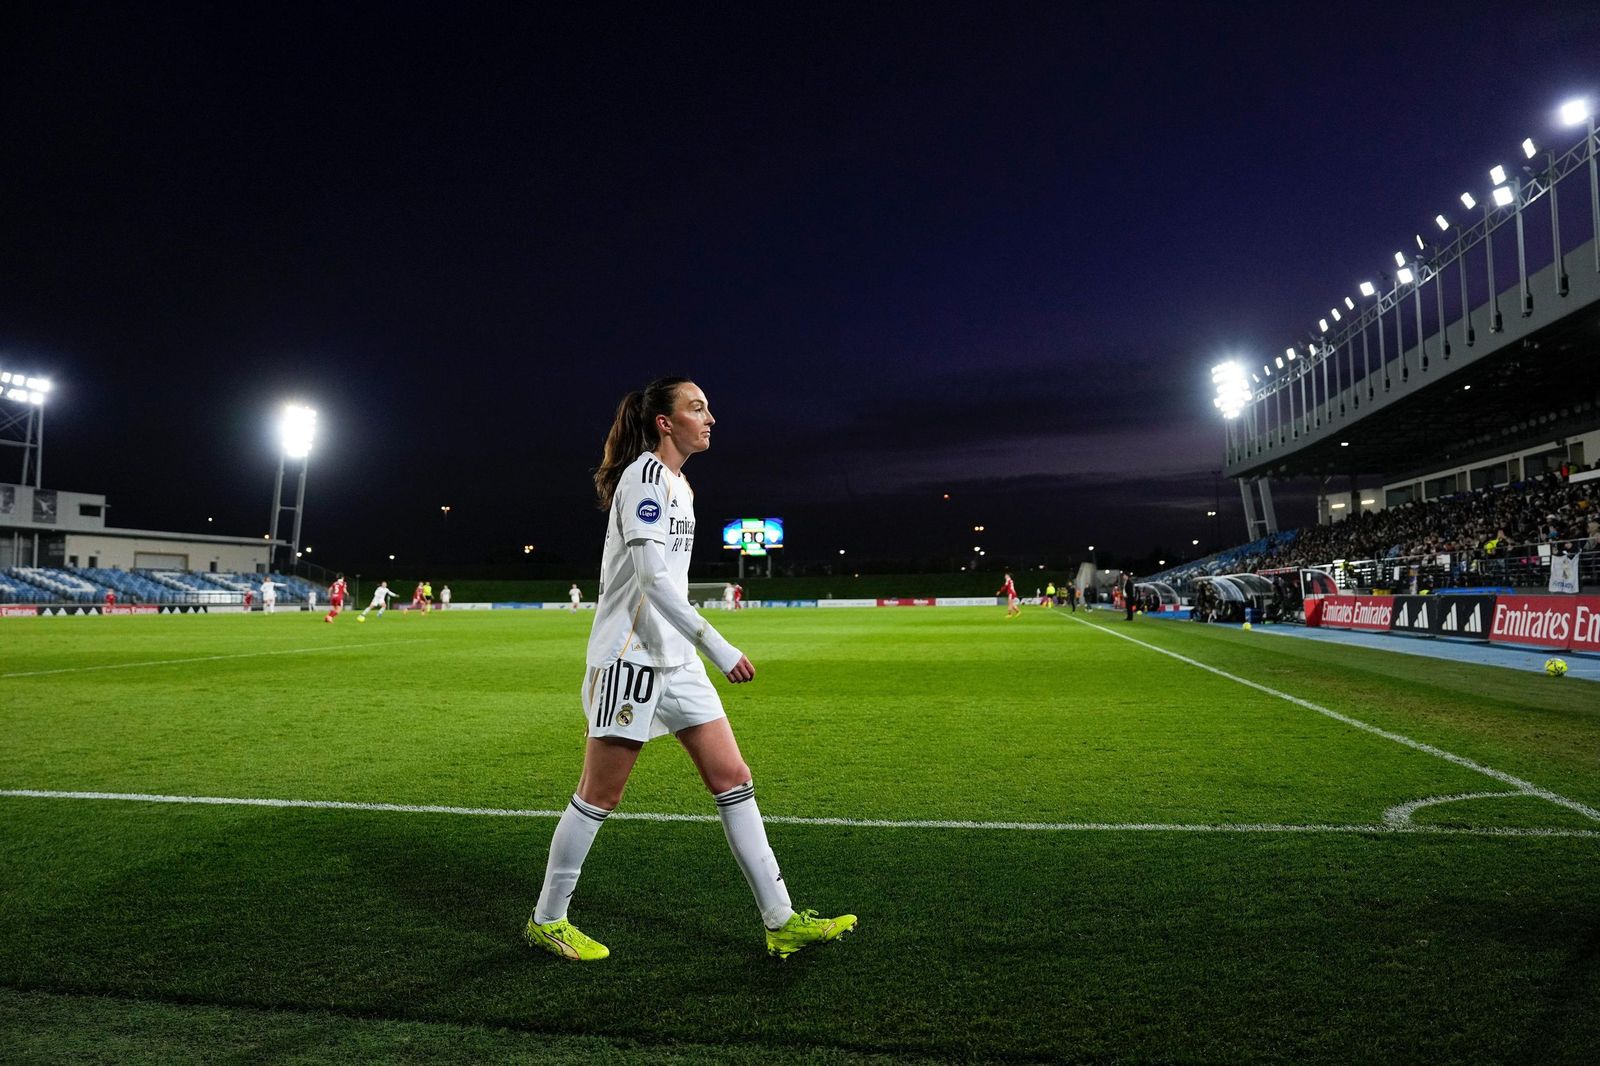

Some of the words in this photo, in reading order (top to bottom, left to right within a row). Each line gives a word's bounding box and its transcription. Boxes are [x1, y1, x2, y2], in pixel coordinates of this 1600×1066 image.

[1322, 601, 1353, 622] Emirates
[1353, 601, 1392, 625] Emirates
[1493, 603, 1571, 640] Emirates
[622, 661, 655, 704] 10
